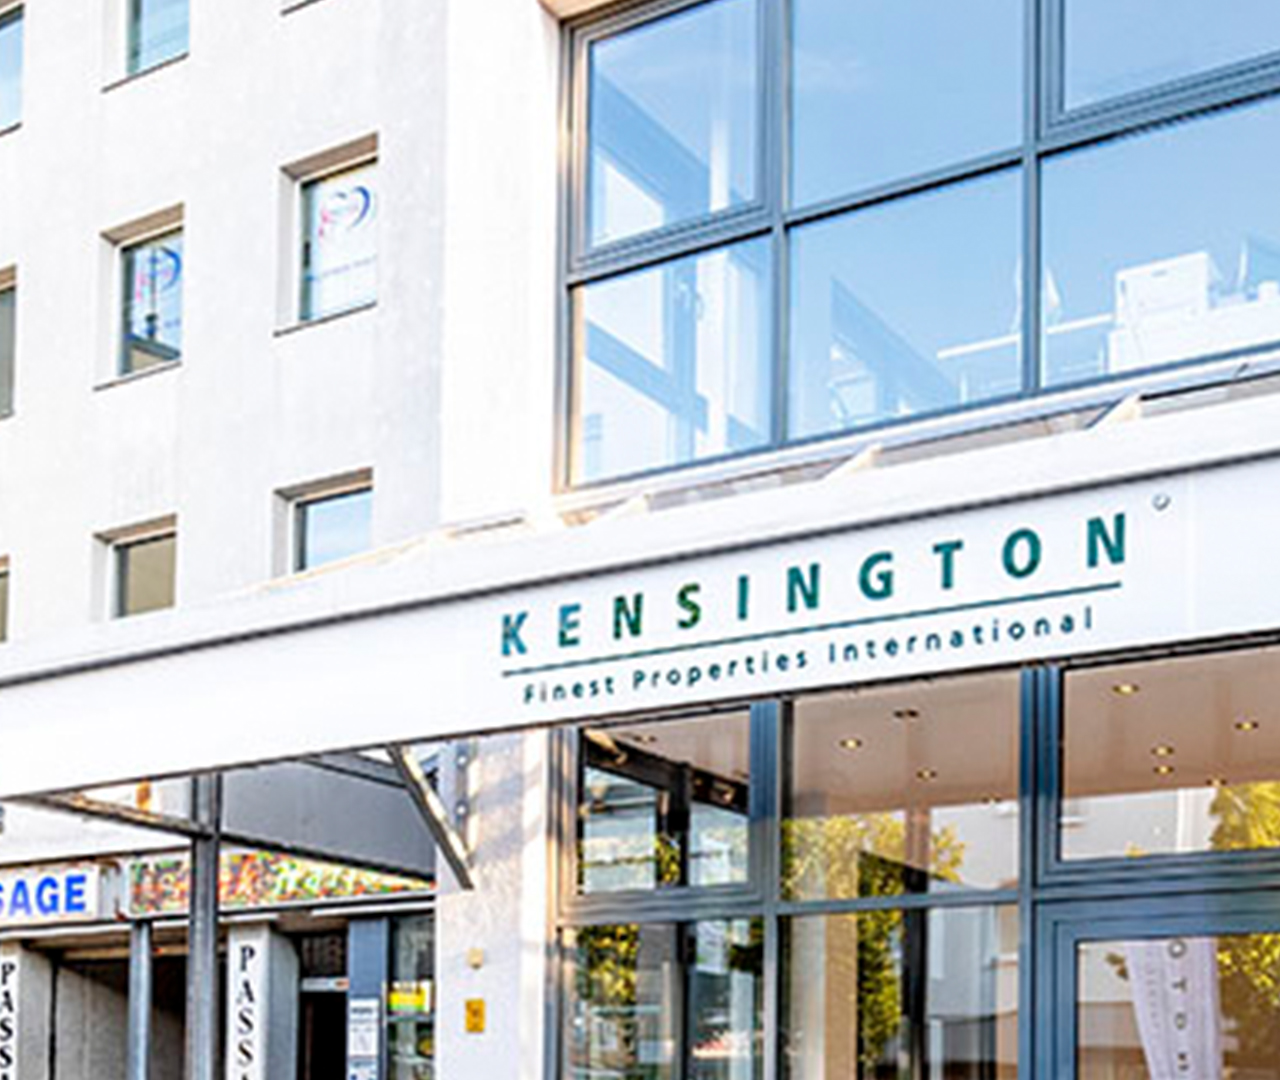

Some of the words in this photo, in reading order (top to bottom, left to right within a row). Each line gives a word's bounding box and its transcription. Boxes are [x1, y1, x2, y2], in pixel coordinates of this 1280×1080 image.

[500, 512, 1127, 658] KENSINGTON
[523, 676, 615, 704] Finest
[632, 648, 808, 690] Properties
[828, 605, 1093, 664] International
